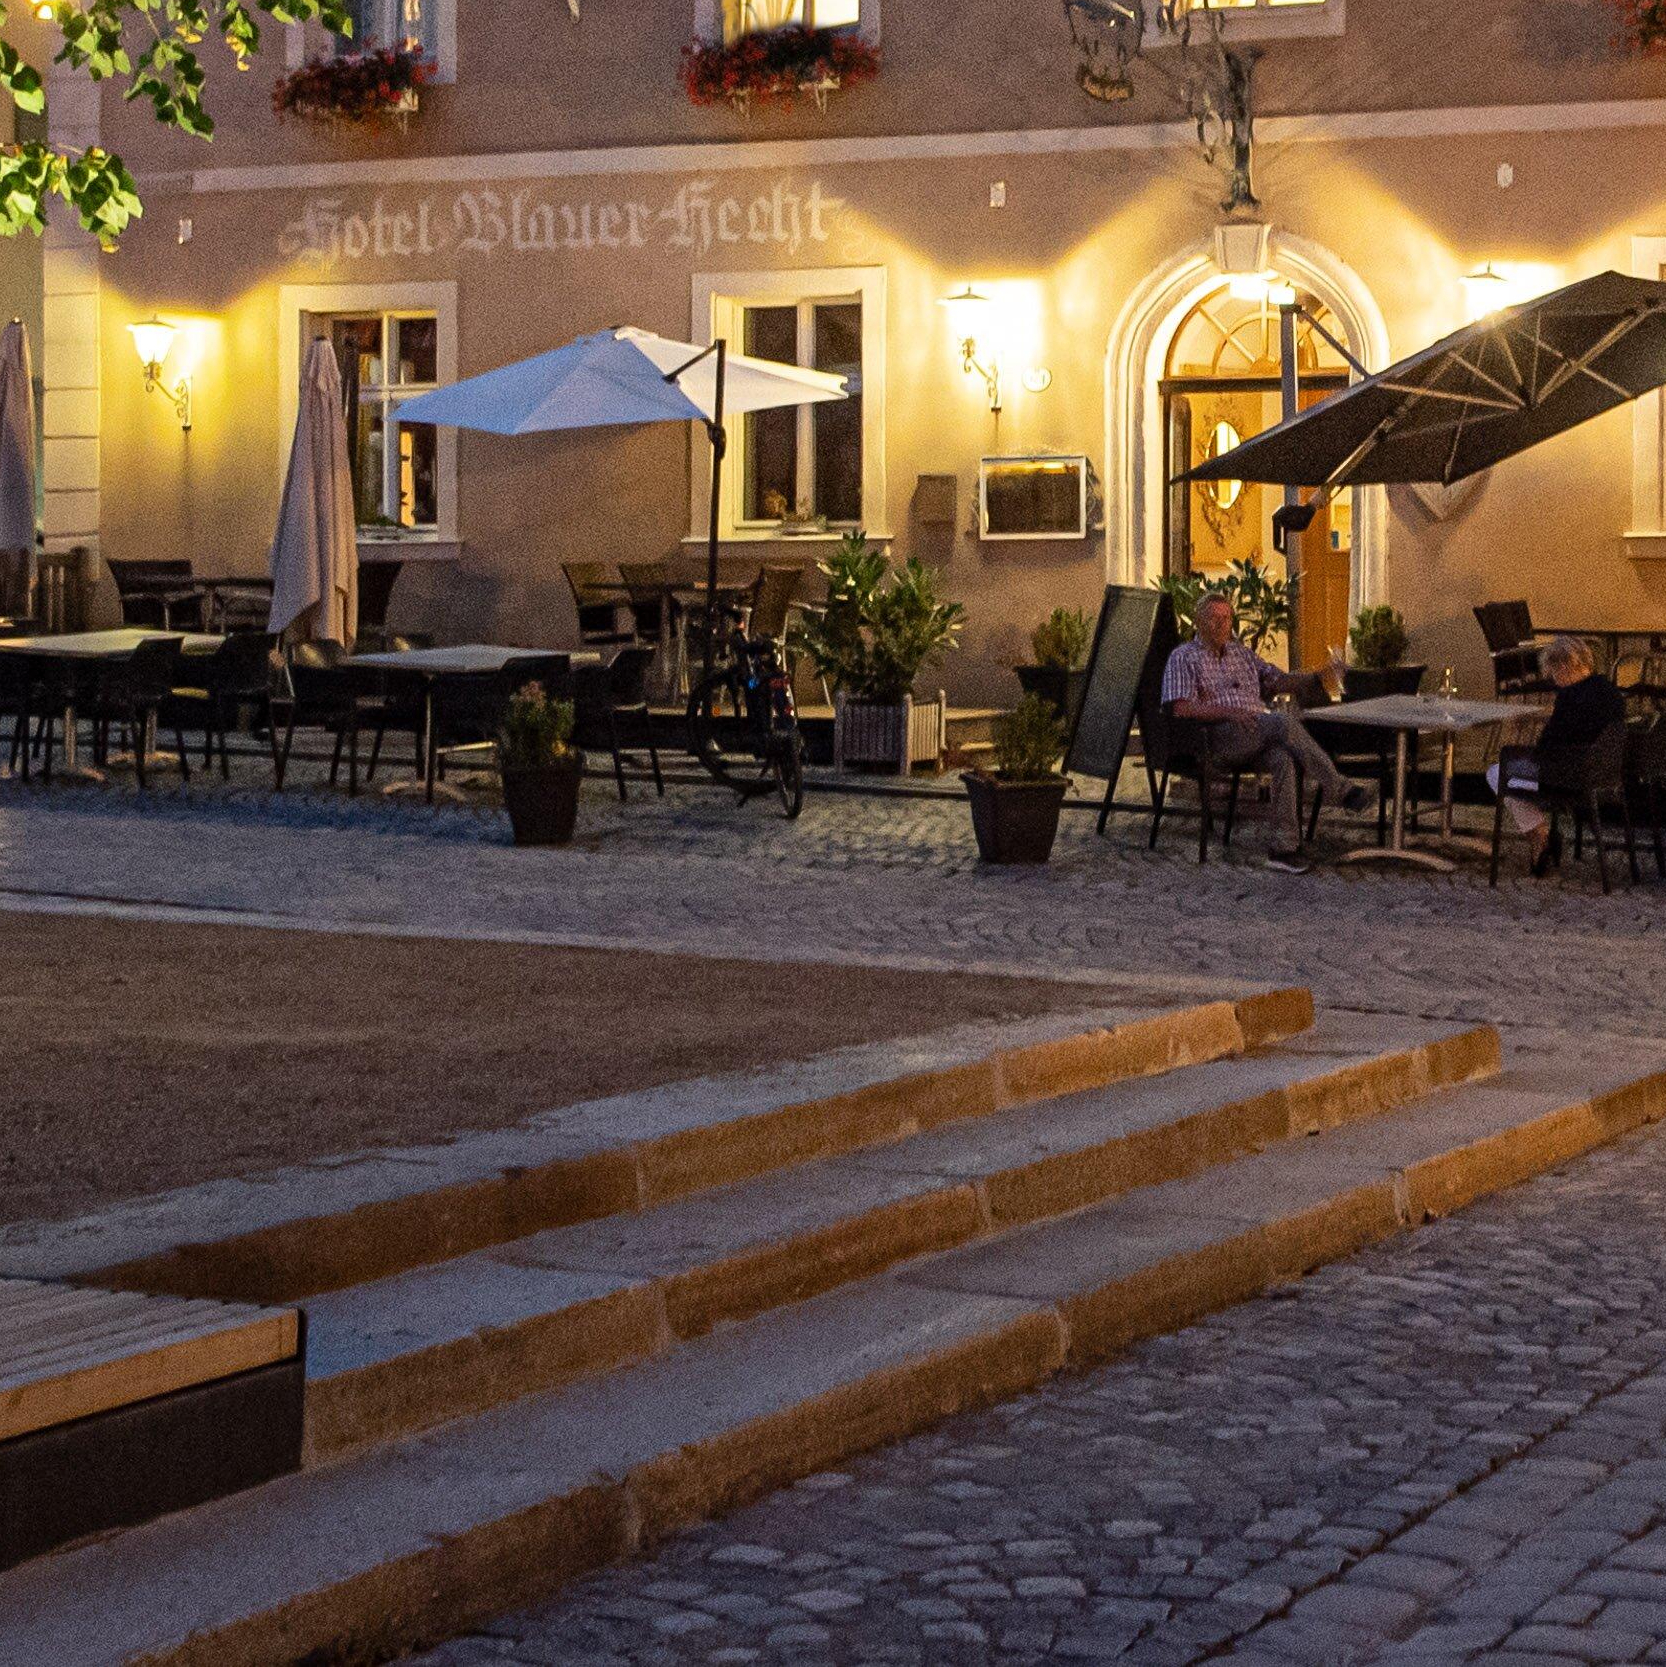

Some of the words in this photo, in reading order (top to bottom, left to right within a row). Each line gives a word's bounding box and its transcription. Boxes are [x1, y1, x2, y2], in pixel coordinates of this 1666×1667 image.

[279, 196, 433, 262] Hotel
[452, 184, 655, 257] Blauer
[657, 176, 845, 257] Hecht
